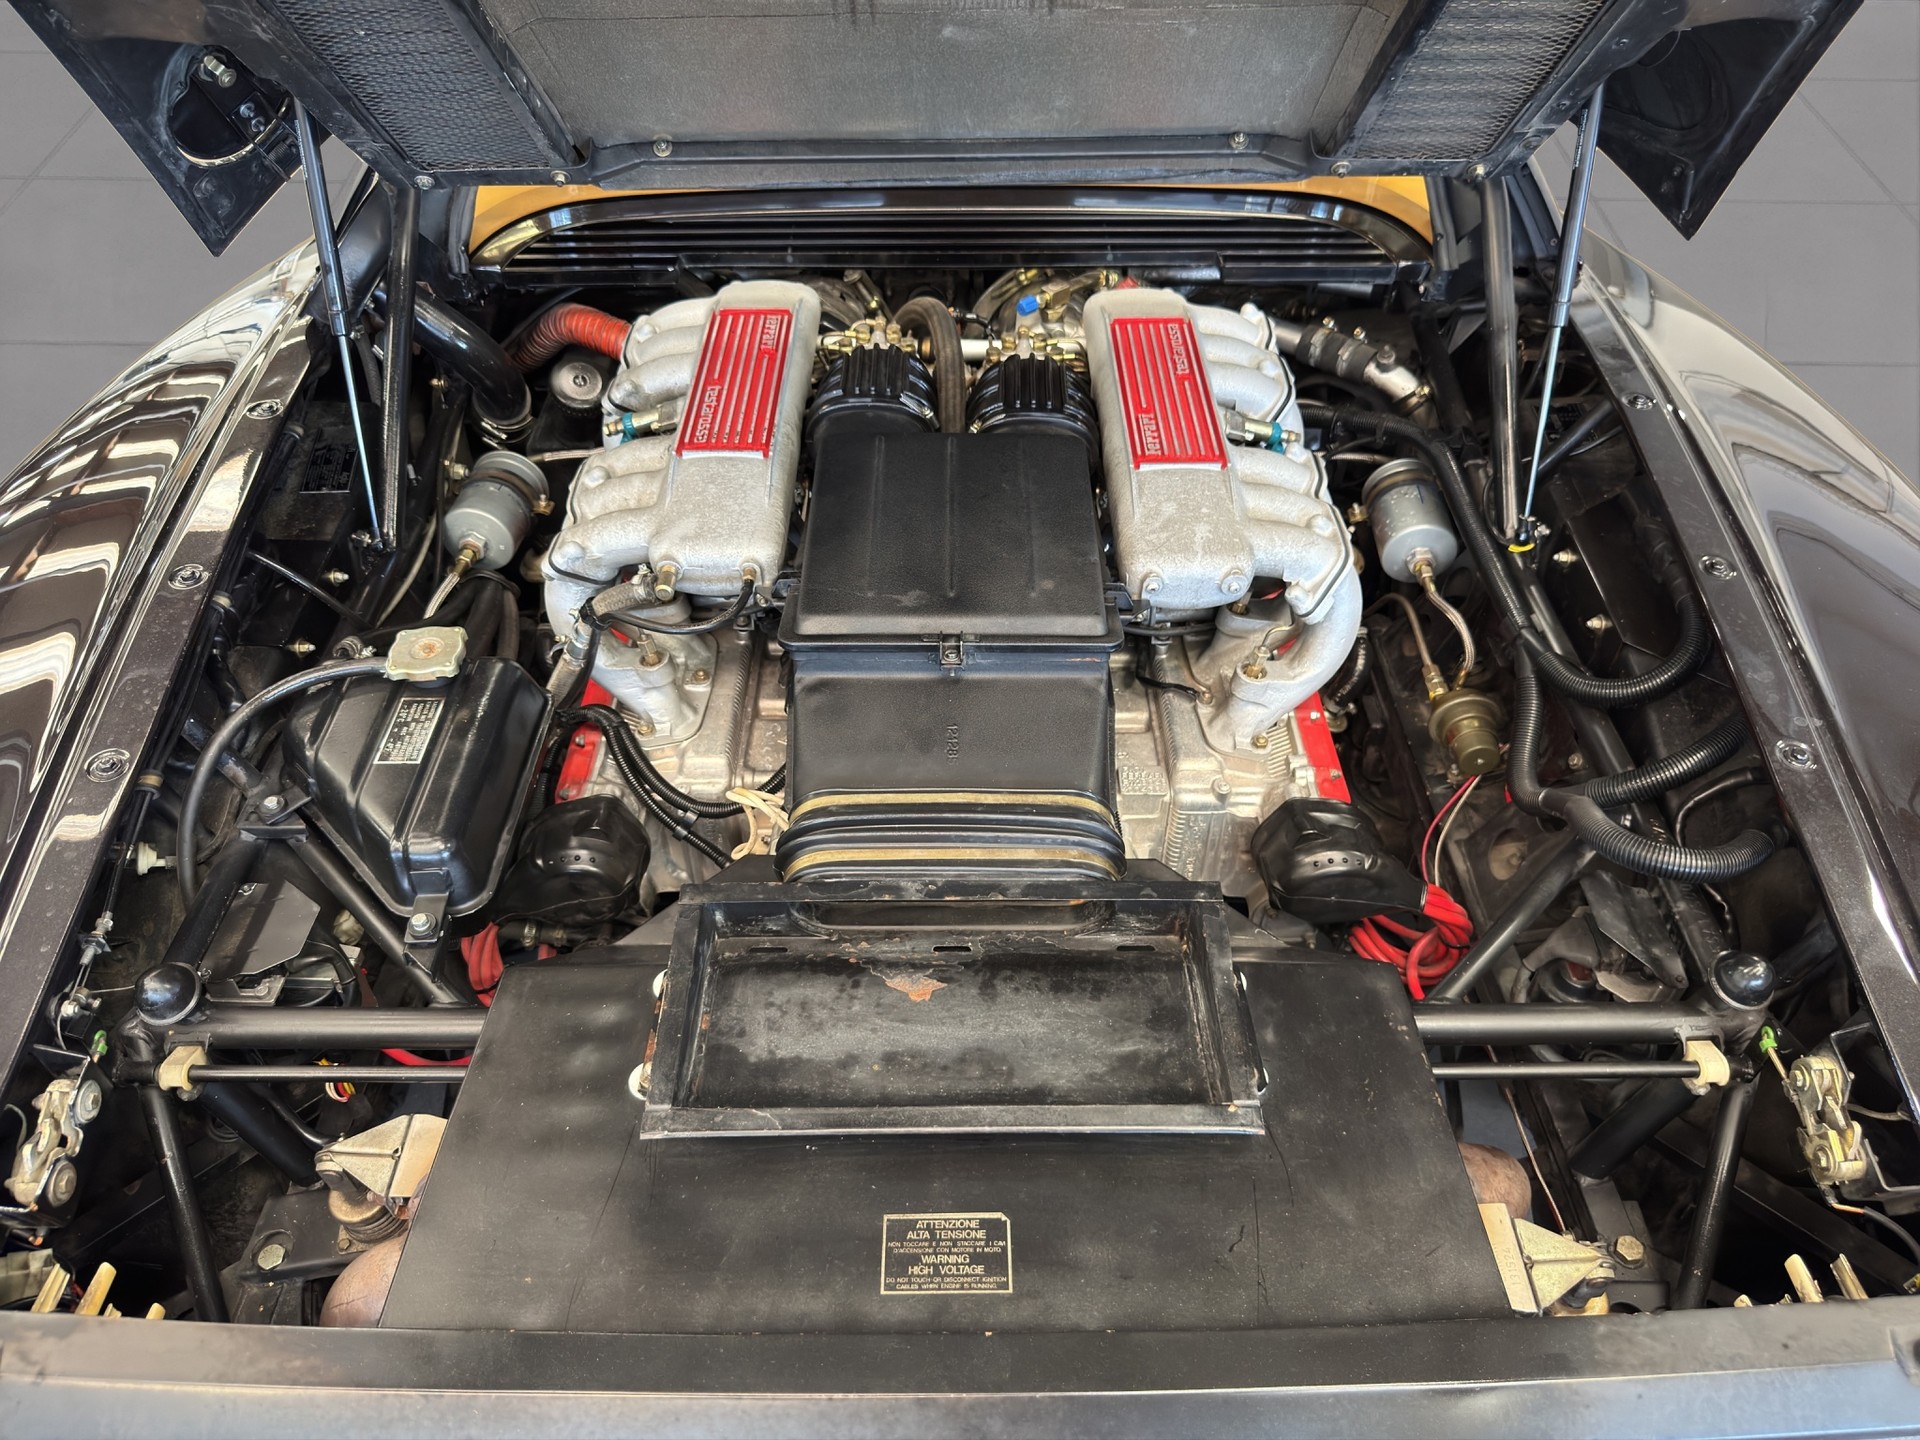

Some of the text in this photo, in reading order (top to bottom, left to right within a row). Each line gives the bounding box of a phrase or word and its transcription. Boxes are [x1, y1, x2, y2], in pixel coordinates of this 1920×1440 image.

[916, 1219, 980, 1229] ATTENZIONE
[906, 1229, 987, 1239] ALTA TENSIONE
[921, 1254, 970, 1264] WARNING
[908, 1265, 984, 1275] HIGH VOLTAGE
